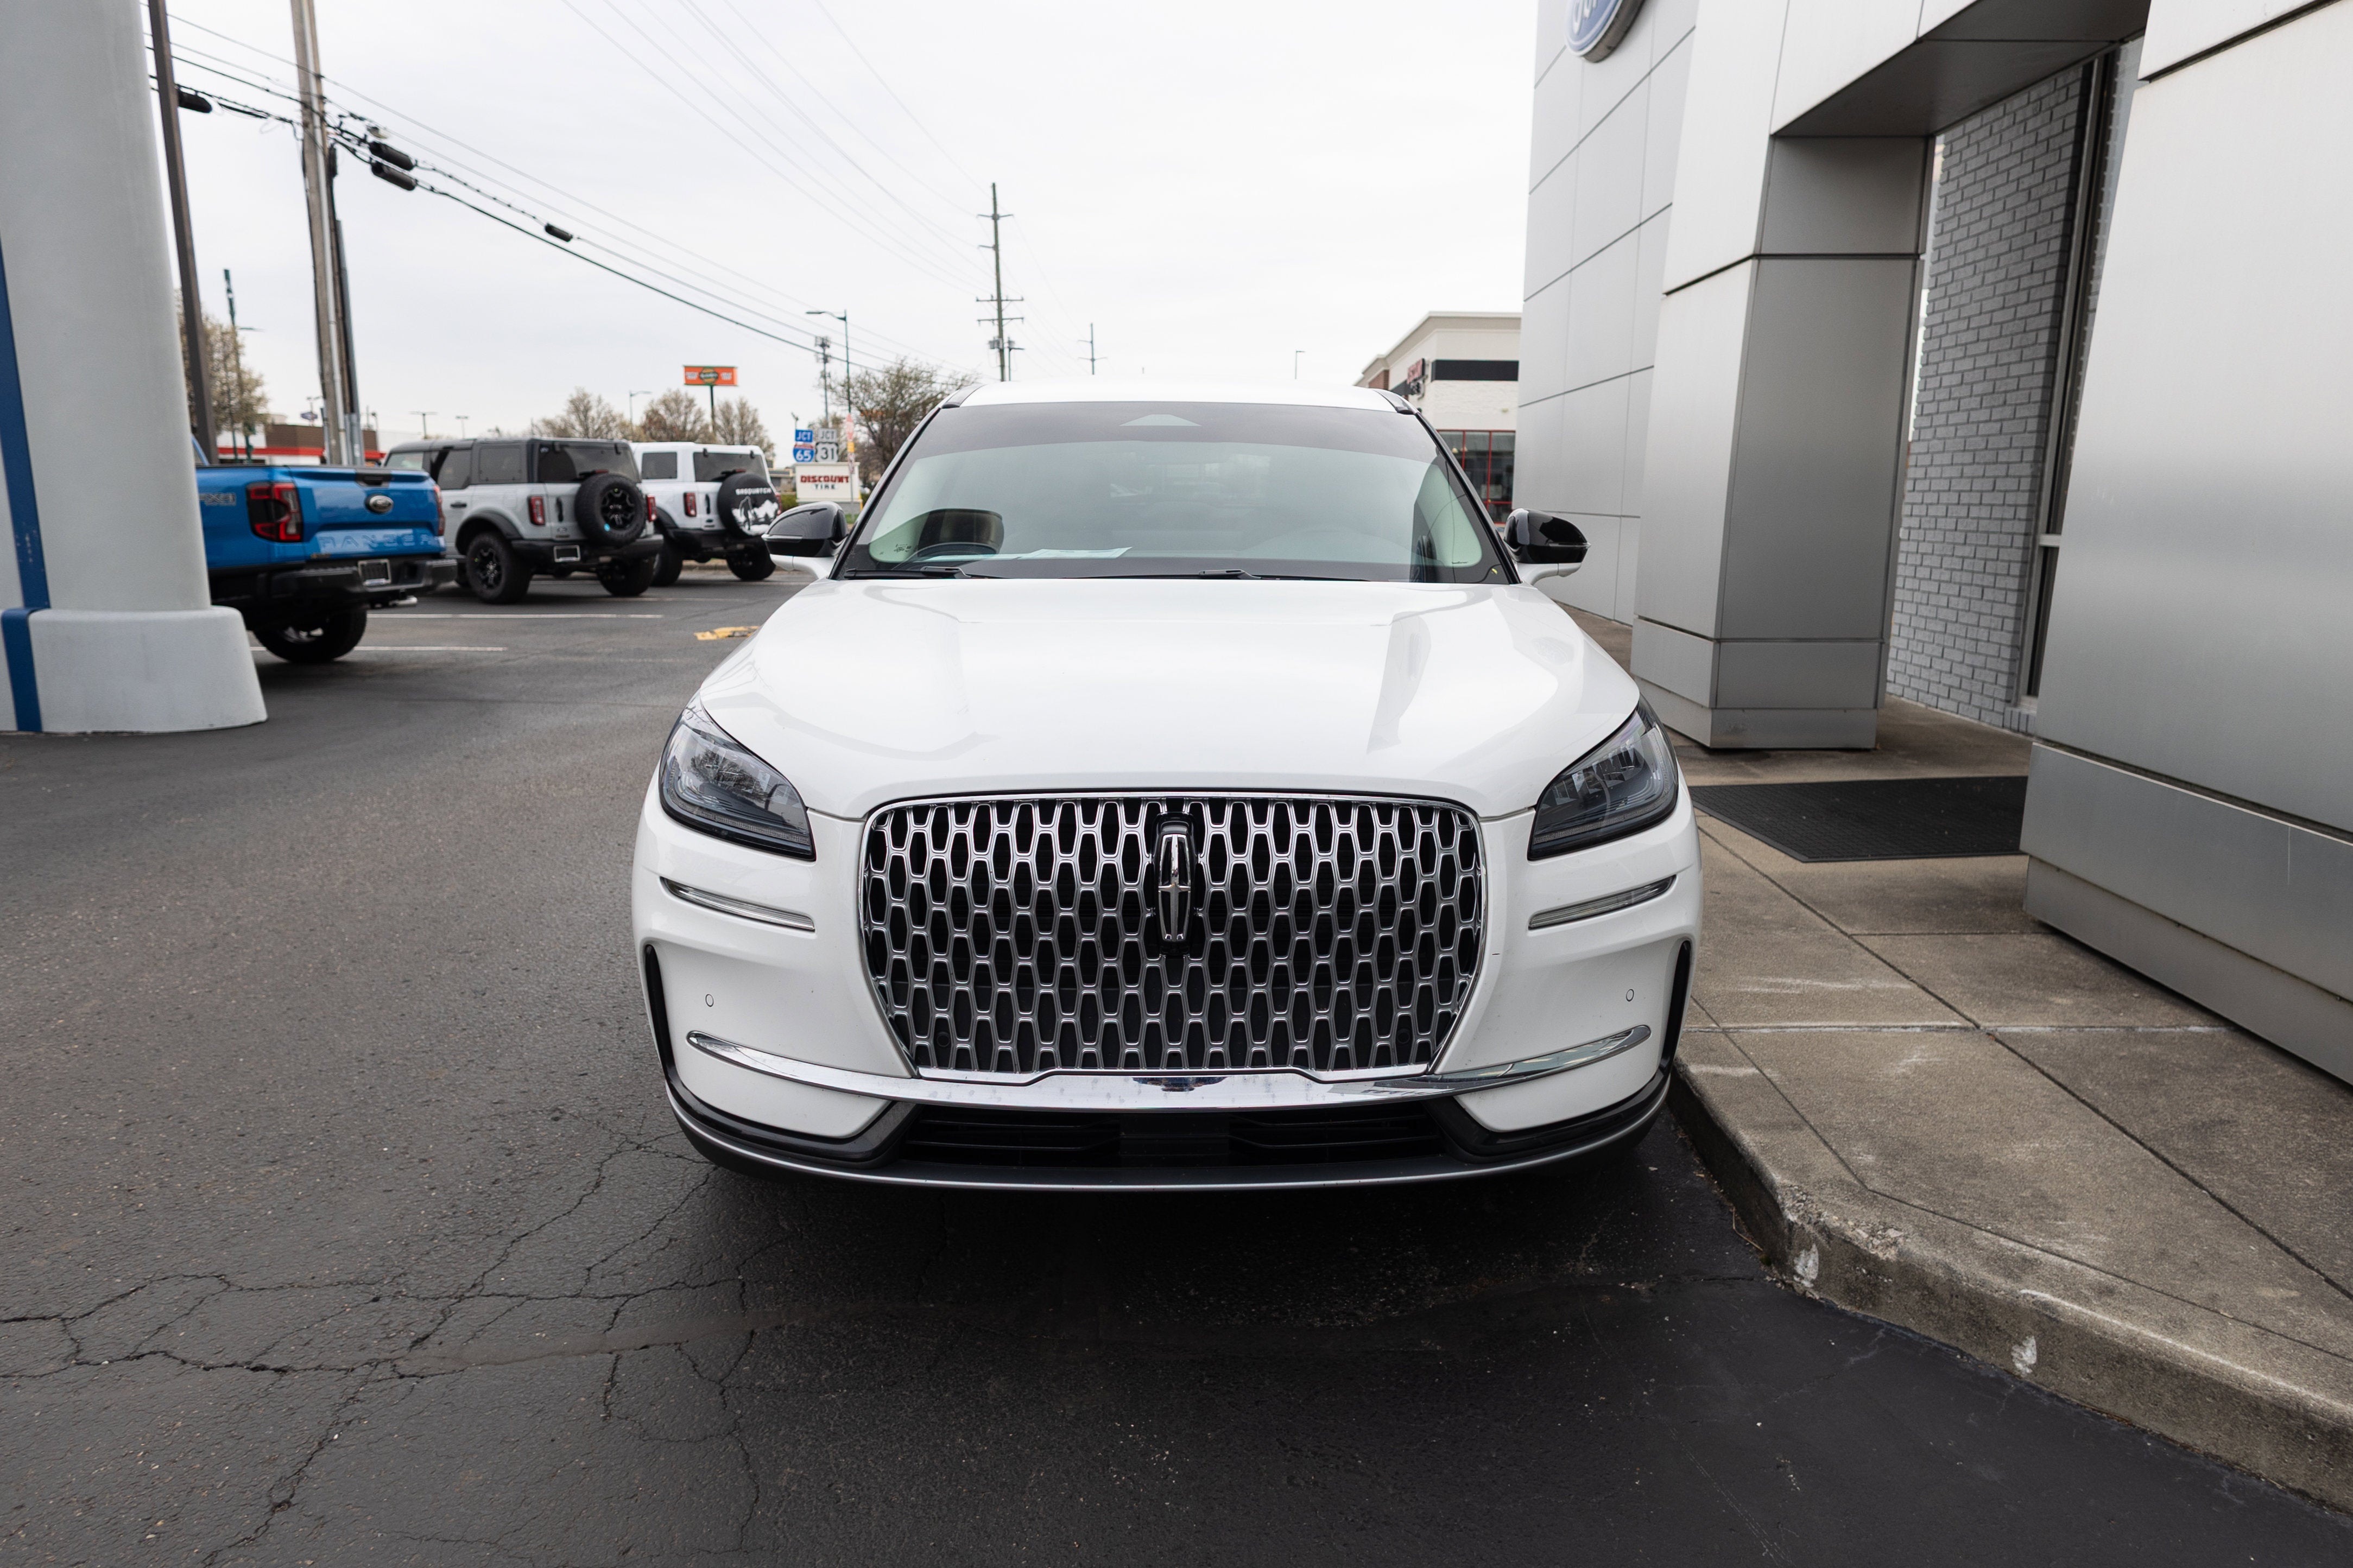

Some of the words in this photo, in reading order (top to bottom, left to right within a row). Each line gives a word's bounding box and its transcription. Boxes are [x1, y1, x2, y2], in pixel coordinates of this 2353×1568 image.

[796, 431, 811, 441] JCT
[821, 430, 834, 439] JCT
[795, 450, 812, 461] 65
[820, 447, 834, 460] 31
[318, 534, 432, 549] RANGER
